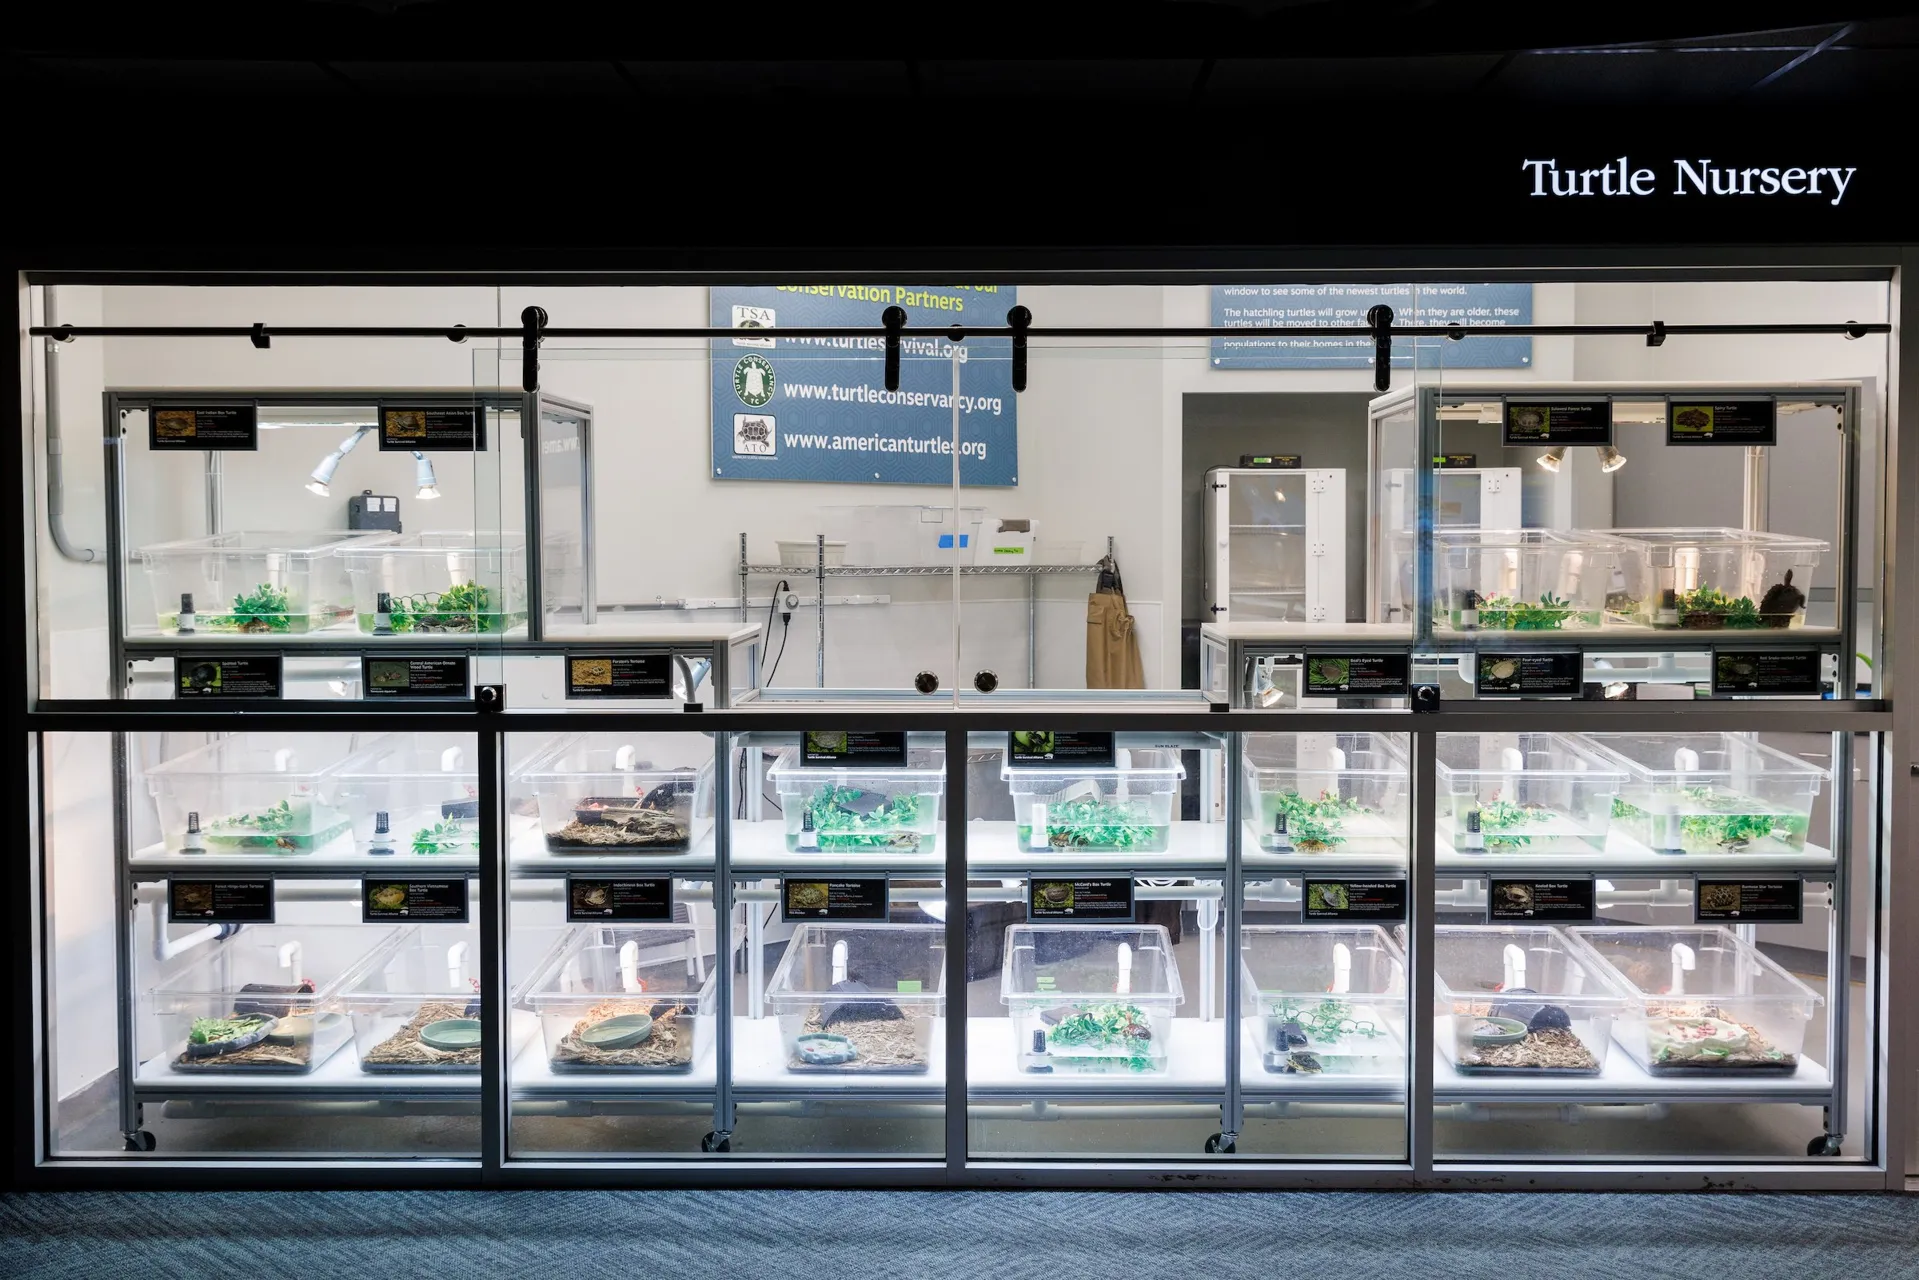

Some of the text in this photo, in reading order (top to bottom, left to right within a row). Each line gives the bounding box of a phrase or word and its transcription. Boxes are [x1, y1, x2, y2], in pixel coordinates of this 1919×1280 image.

[1522, 156, 1857, 206] Turtle Nursery
[1224, 287, 1258, 296] window
[1261, 288, 1270, 296] to
[1317, 287, 1327, 296] of
[1328, 287, 1345, 296] the
[1346, 288, 1379, 296] newest
[1381, 287, 1410, 296] turtles
[1423, 287, 1438, 296] the
[1440, 287, 1467, 296] world.
[896, 289, 963, 311] Partners
[737, 306, 771, 320] TSA
[1224, 308, 1241, 316] The
[1243, 308, 1284, 318] hatchling
[1287, 308, 1315, 316] turtles
[1318, 308, 1333, 316] will
[1399, 307, 1425, 316] When
[1428, 307, 1448, 318] they
[1467, 307, 1491, 316] older,
[1494, 307, 1519, 316] these
[1224, 340, 1371, 350] populations to their homes in the
[743, 443, 767, 454] ATO
